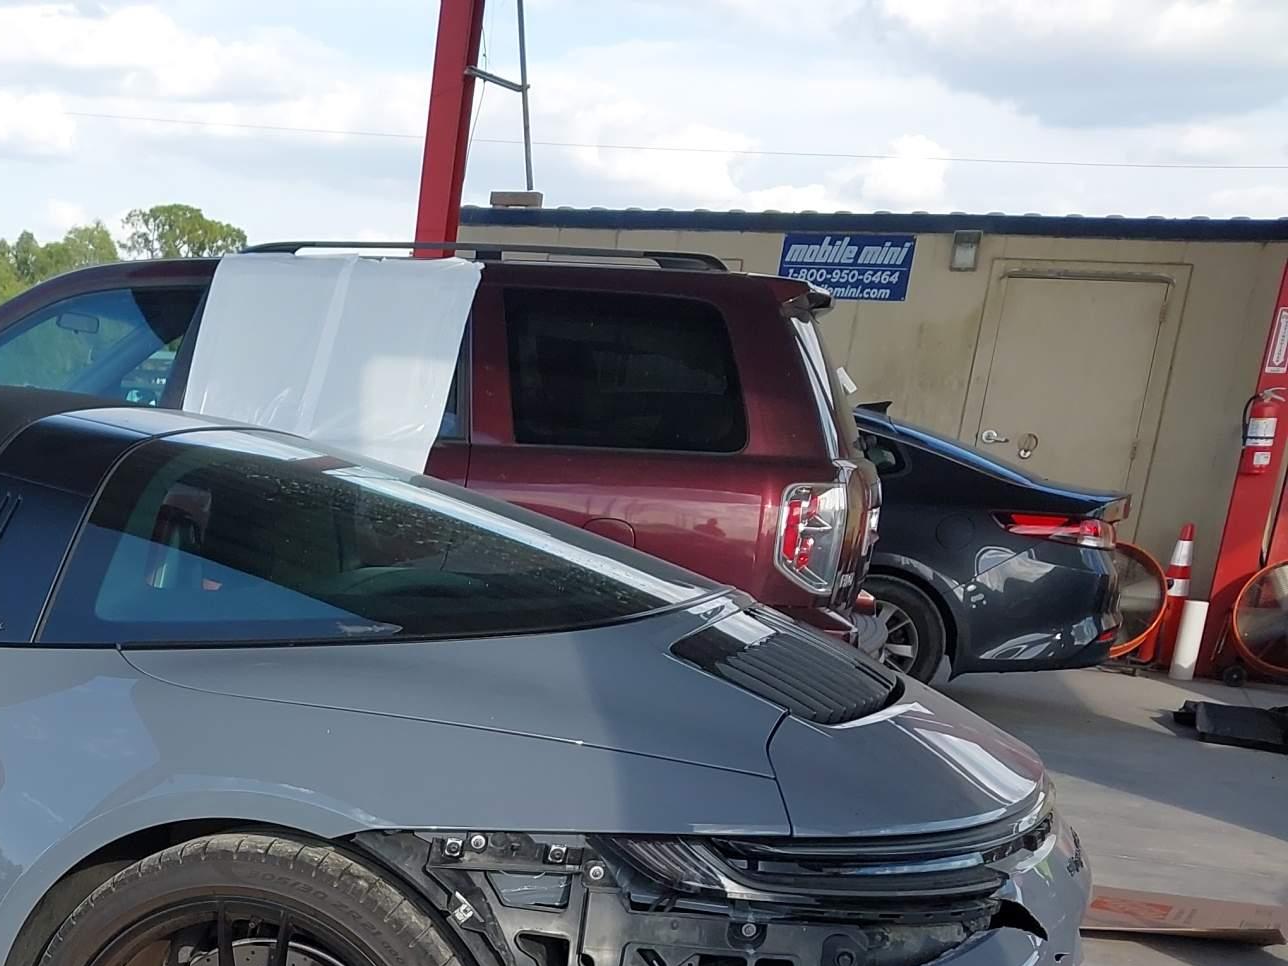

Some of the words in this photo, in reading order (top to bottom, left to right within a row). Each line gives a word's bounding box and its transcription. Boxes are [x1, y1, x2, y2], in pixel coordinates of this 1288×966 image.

[784, 236, 859, 264] mobile
[857, 241, 912, 265] mini
[787, 268, 900, 285] 1-800-950-6464
